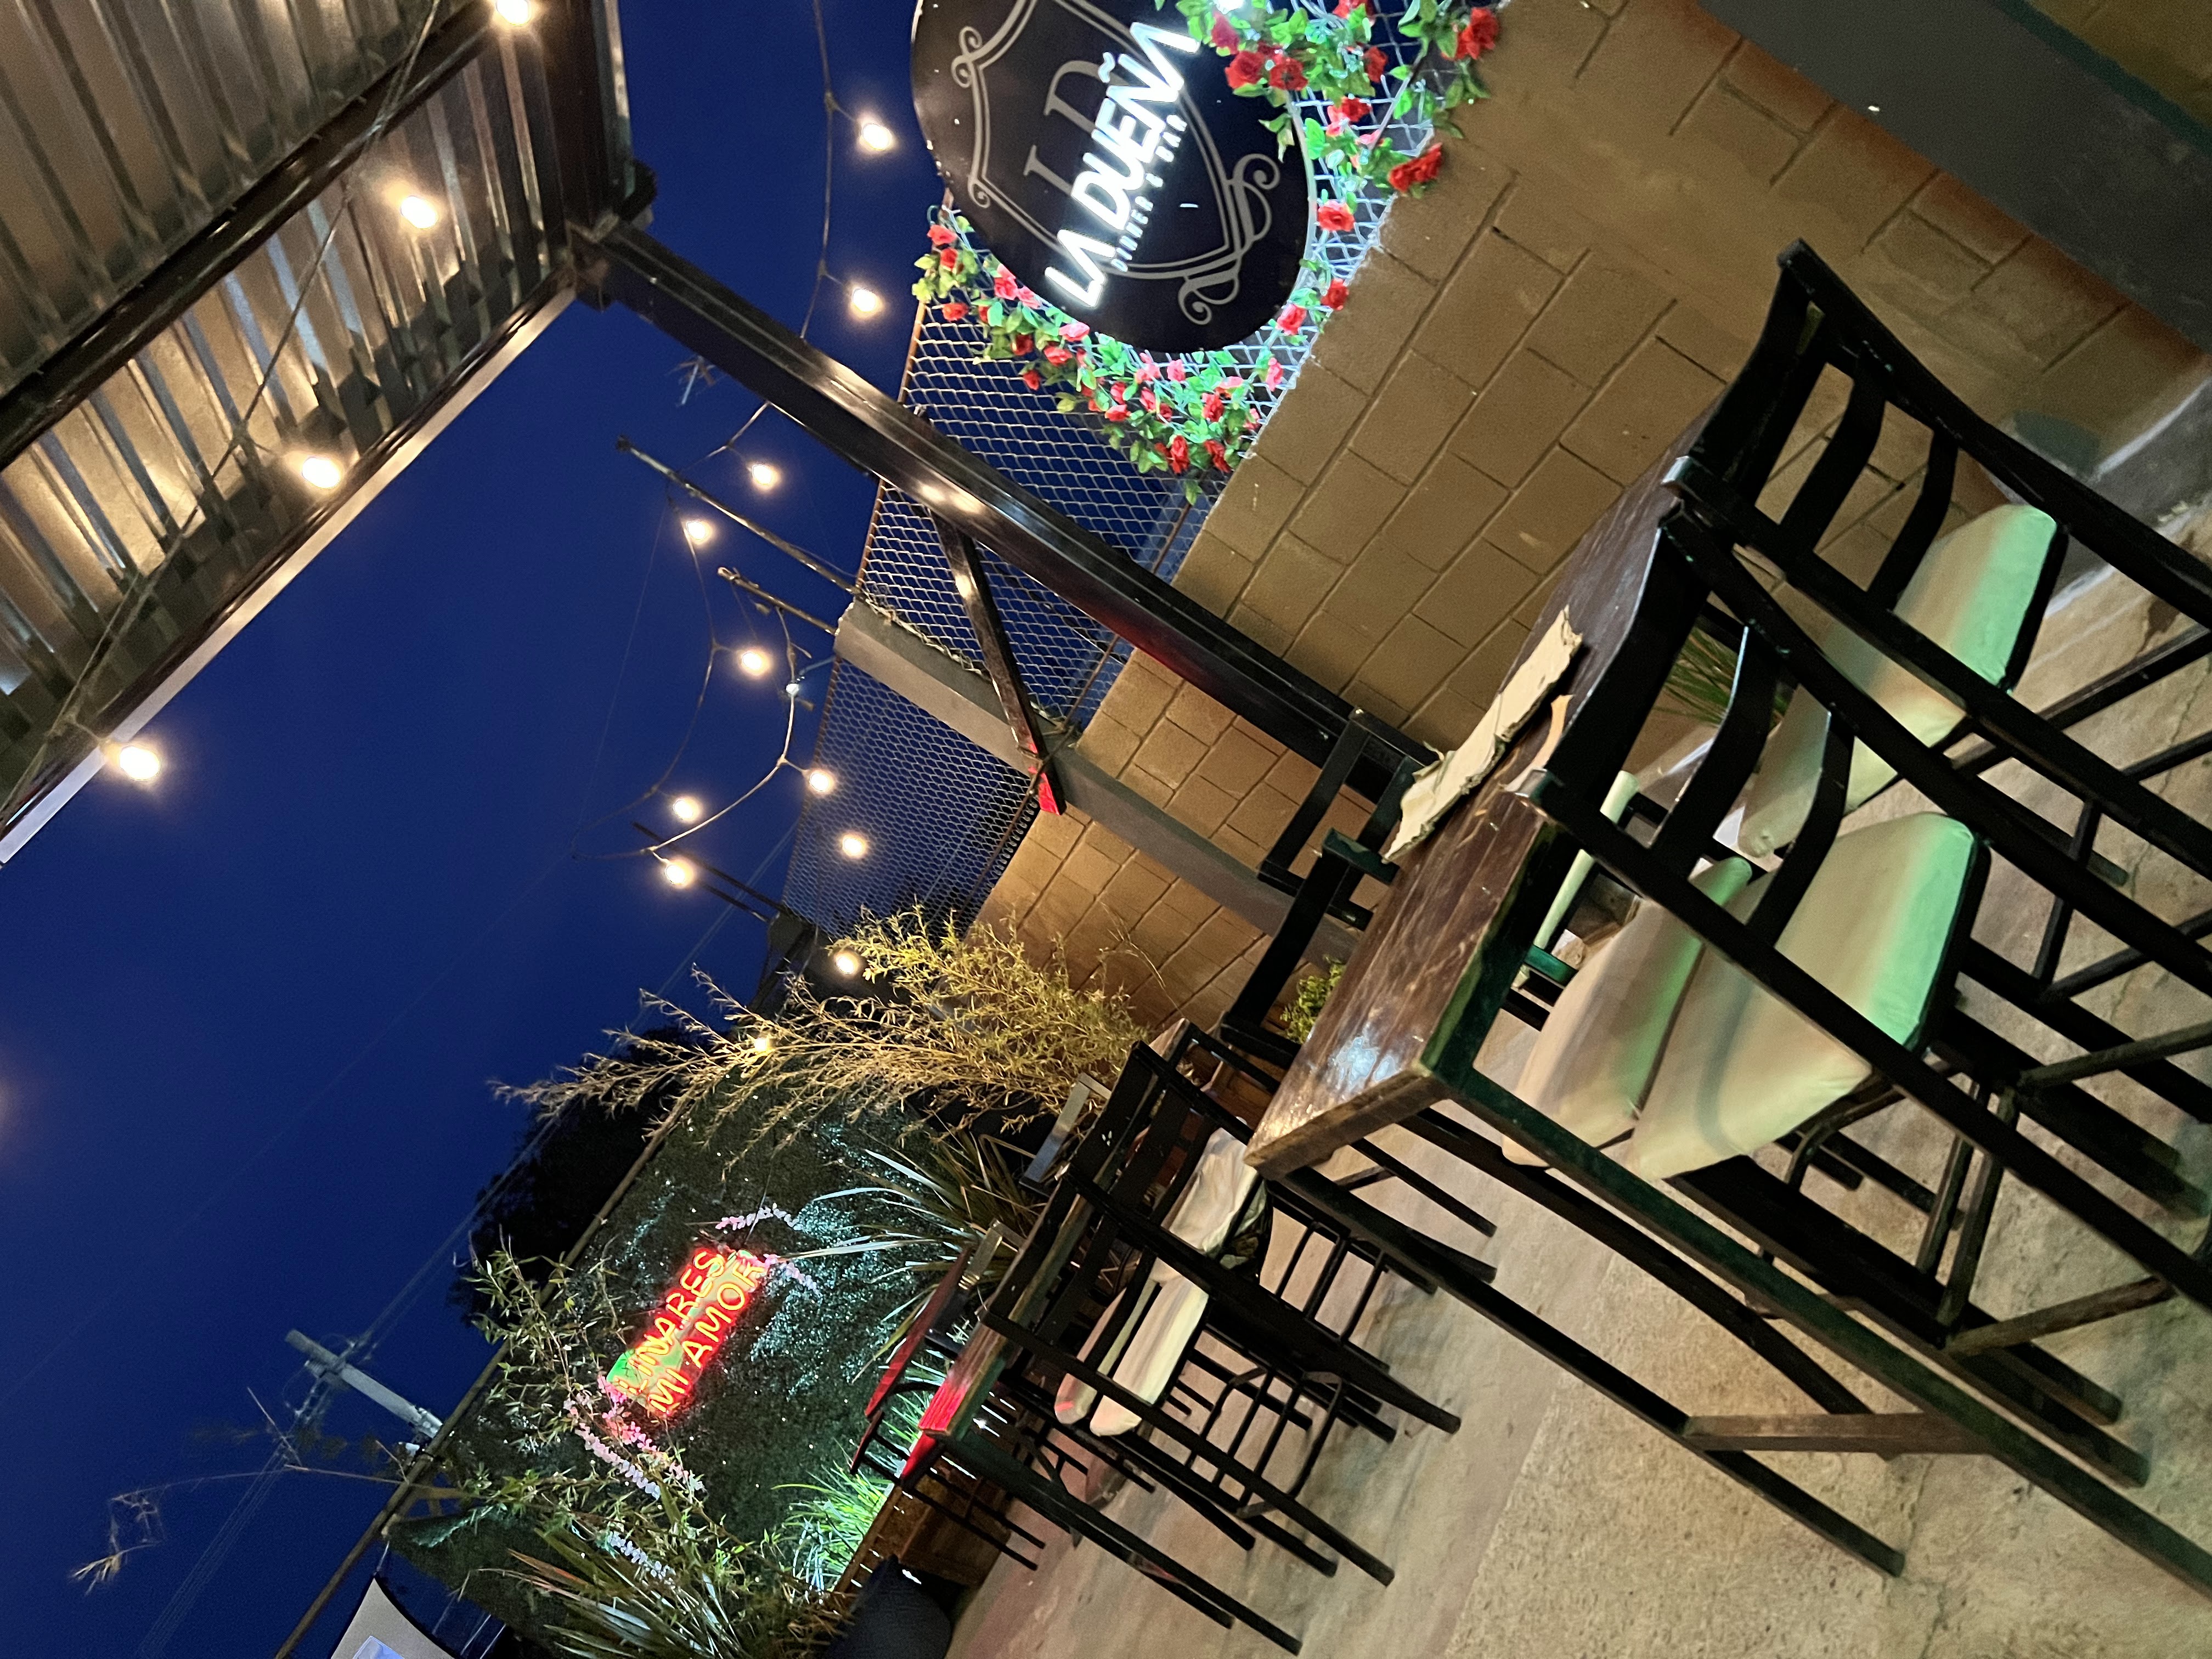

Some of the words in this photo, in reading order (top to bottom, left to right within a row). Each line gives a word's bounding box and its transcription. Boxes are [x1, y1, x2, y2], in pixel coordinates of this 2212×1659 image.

[1071, 22, 1200, 231] DUEÑA
[1111, 195, 1154, 272] DINNER
[1155, 114, 1187, 163] BAR
[1045, 229, 1116, 307] LA
[613, 1251, 725, 1395] LINARES
[648, 1368, 689, 1413] MI
[682, 1261, 764, 1368] AMOR
